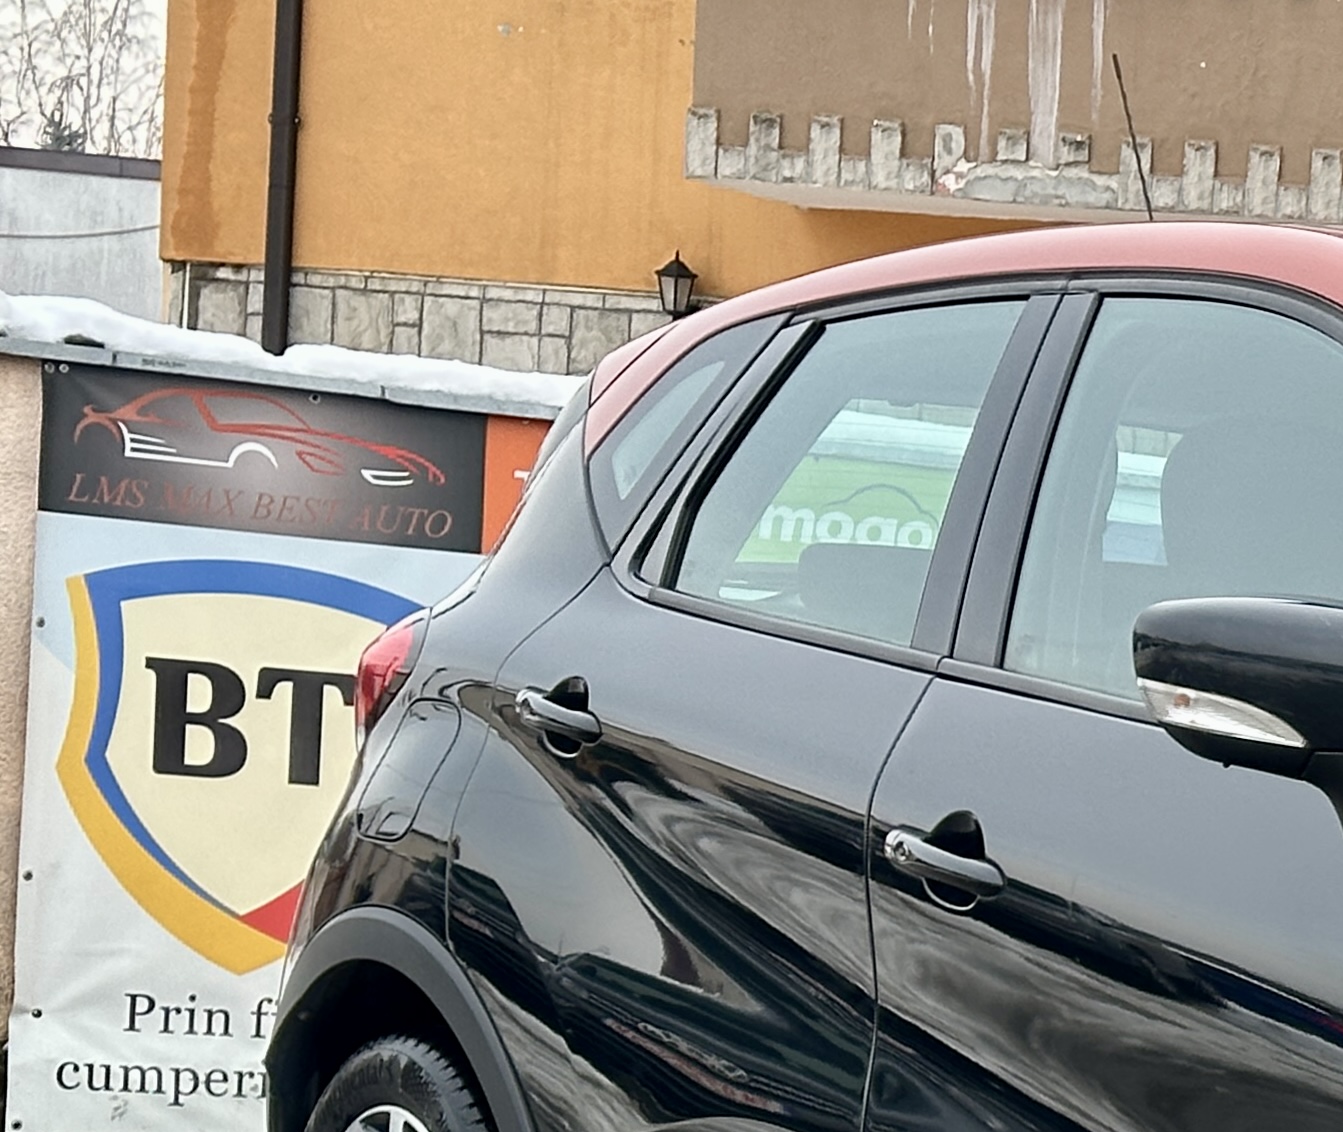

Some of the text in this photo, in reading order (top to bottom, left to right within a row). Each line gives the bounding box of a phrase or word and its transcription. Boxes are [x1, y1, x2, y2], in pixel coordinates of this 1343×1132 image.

[67, 473, 453, 539] LMS MAX BEST AUTO
[145, 655, 358, 787] BT
[122, 992, 234, 1037] Prin
